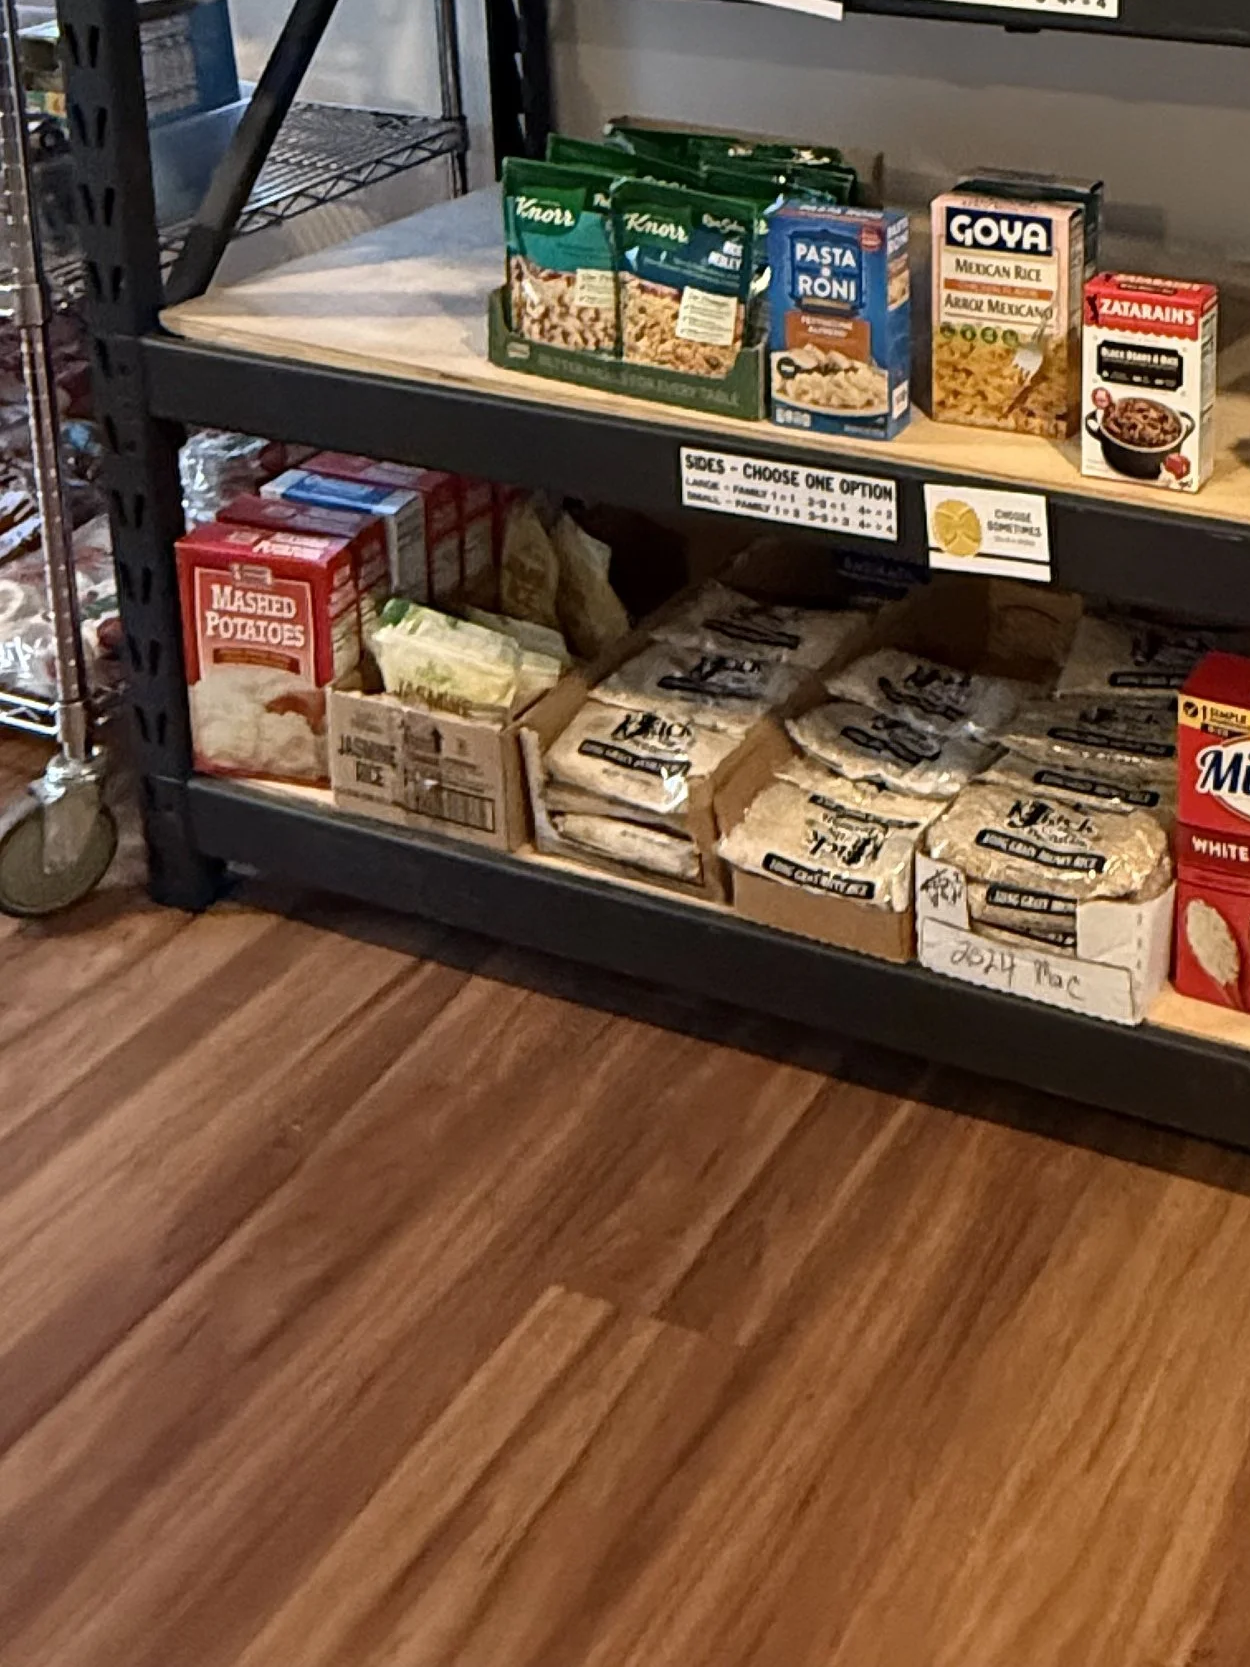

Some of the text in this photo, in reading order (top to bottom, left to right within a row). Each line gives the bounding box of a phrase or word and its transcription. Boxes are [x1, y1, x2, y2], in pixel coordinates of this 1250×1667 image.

[515, 195, 576, 228] Knorr
[623, 212, 690, 244] Knorr
[950, 213, 1048, 253] GOYA
[795, 242, 857, 268] PASTA
[955, 257, 1043, 283] MEXICAN RICE
[798, 276, 857, 302] RONI
[945, 293, 1054, 321] ARROZ MEXICANO
[685, 453, 894, 503] SIDES CHOOSE ONE OPTION
[987, 520, 1043, 538] SOMETIMES
[994, 508, 1033, 524] CHOOSE
[211, 584, 297, 619] MASHED
[205, 611, 305, 648] POTATOES
[1192, 835, 1250, 862] WHITE
[950, 939, 1017, 987] 2024
